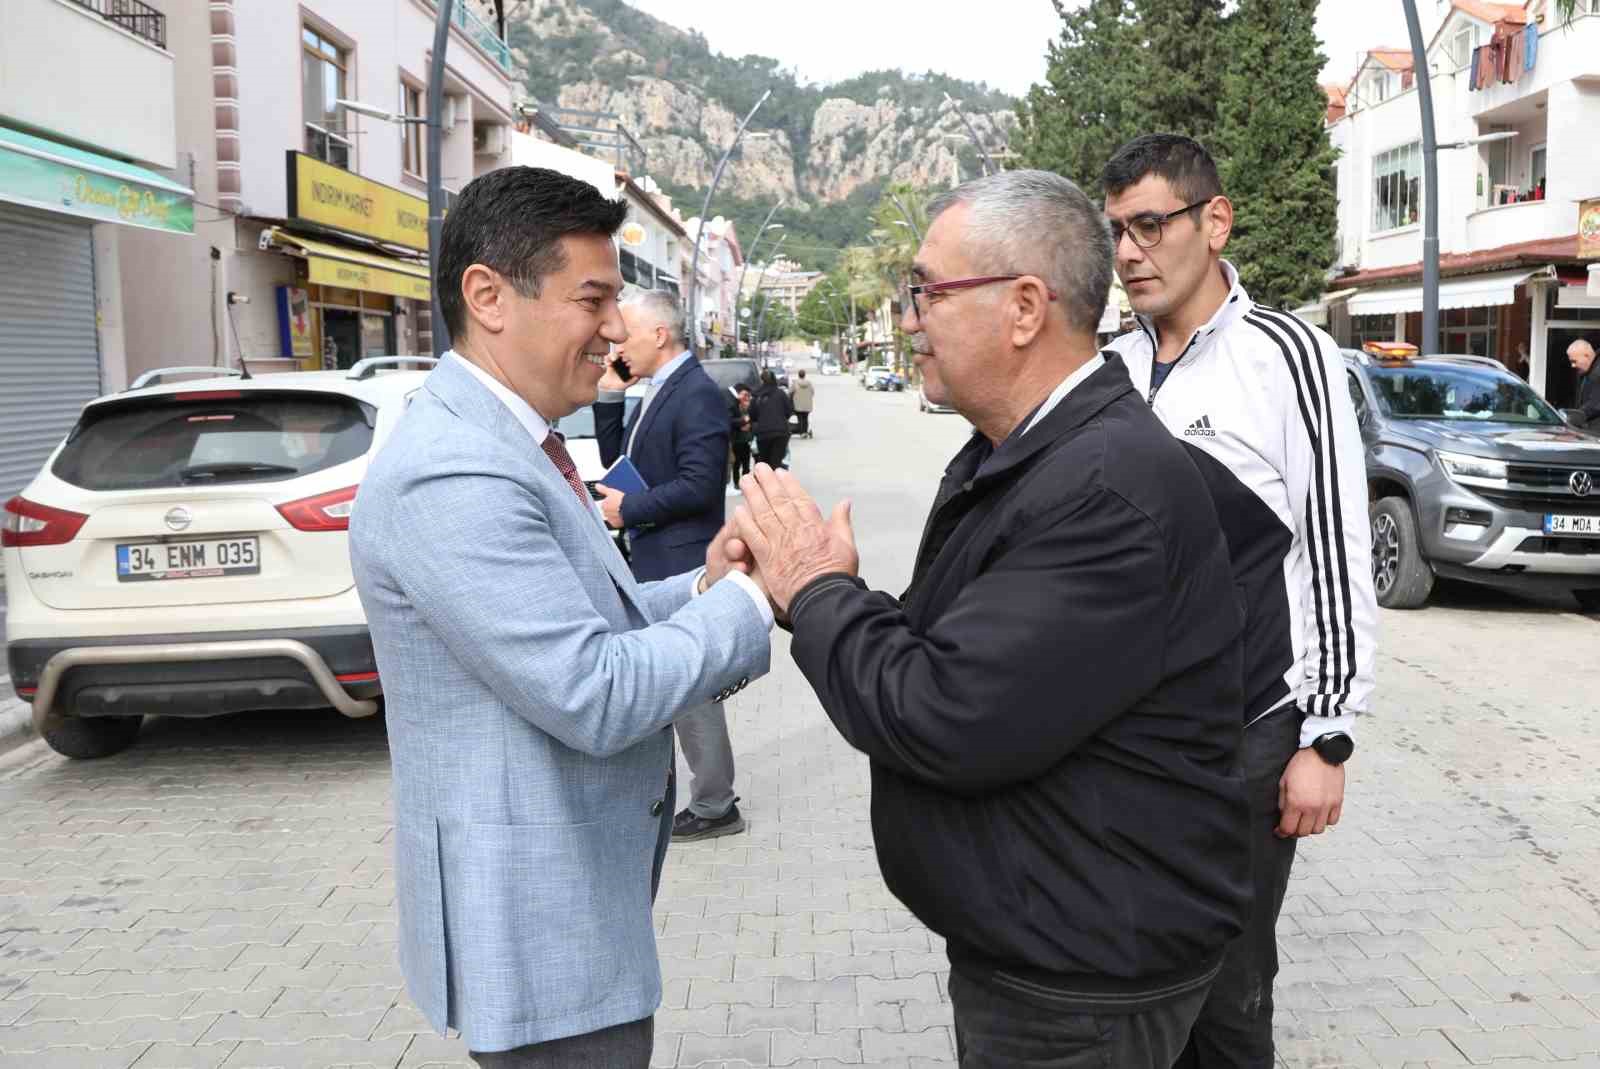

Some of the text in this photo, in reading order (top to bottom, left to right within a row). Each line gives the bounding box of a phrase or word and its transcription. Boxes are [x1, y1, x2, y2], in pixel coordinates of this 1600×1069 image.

[1184, 428, 1215, 437] adidas
[1553, 517, 1591, 531] 34 MDA
[131, 541, 254, 571] 34 ENM 035
